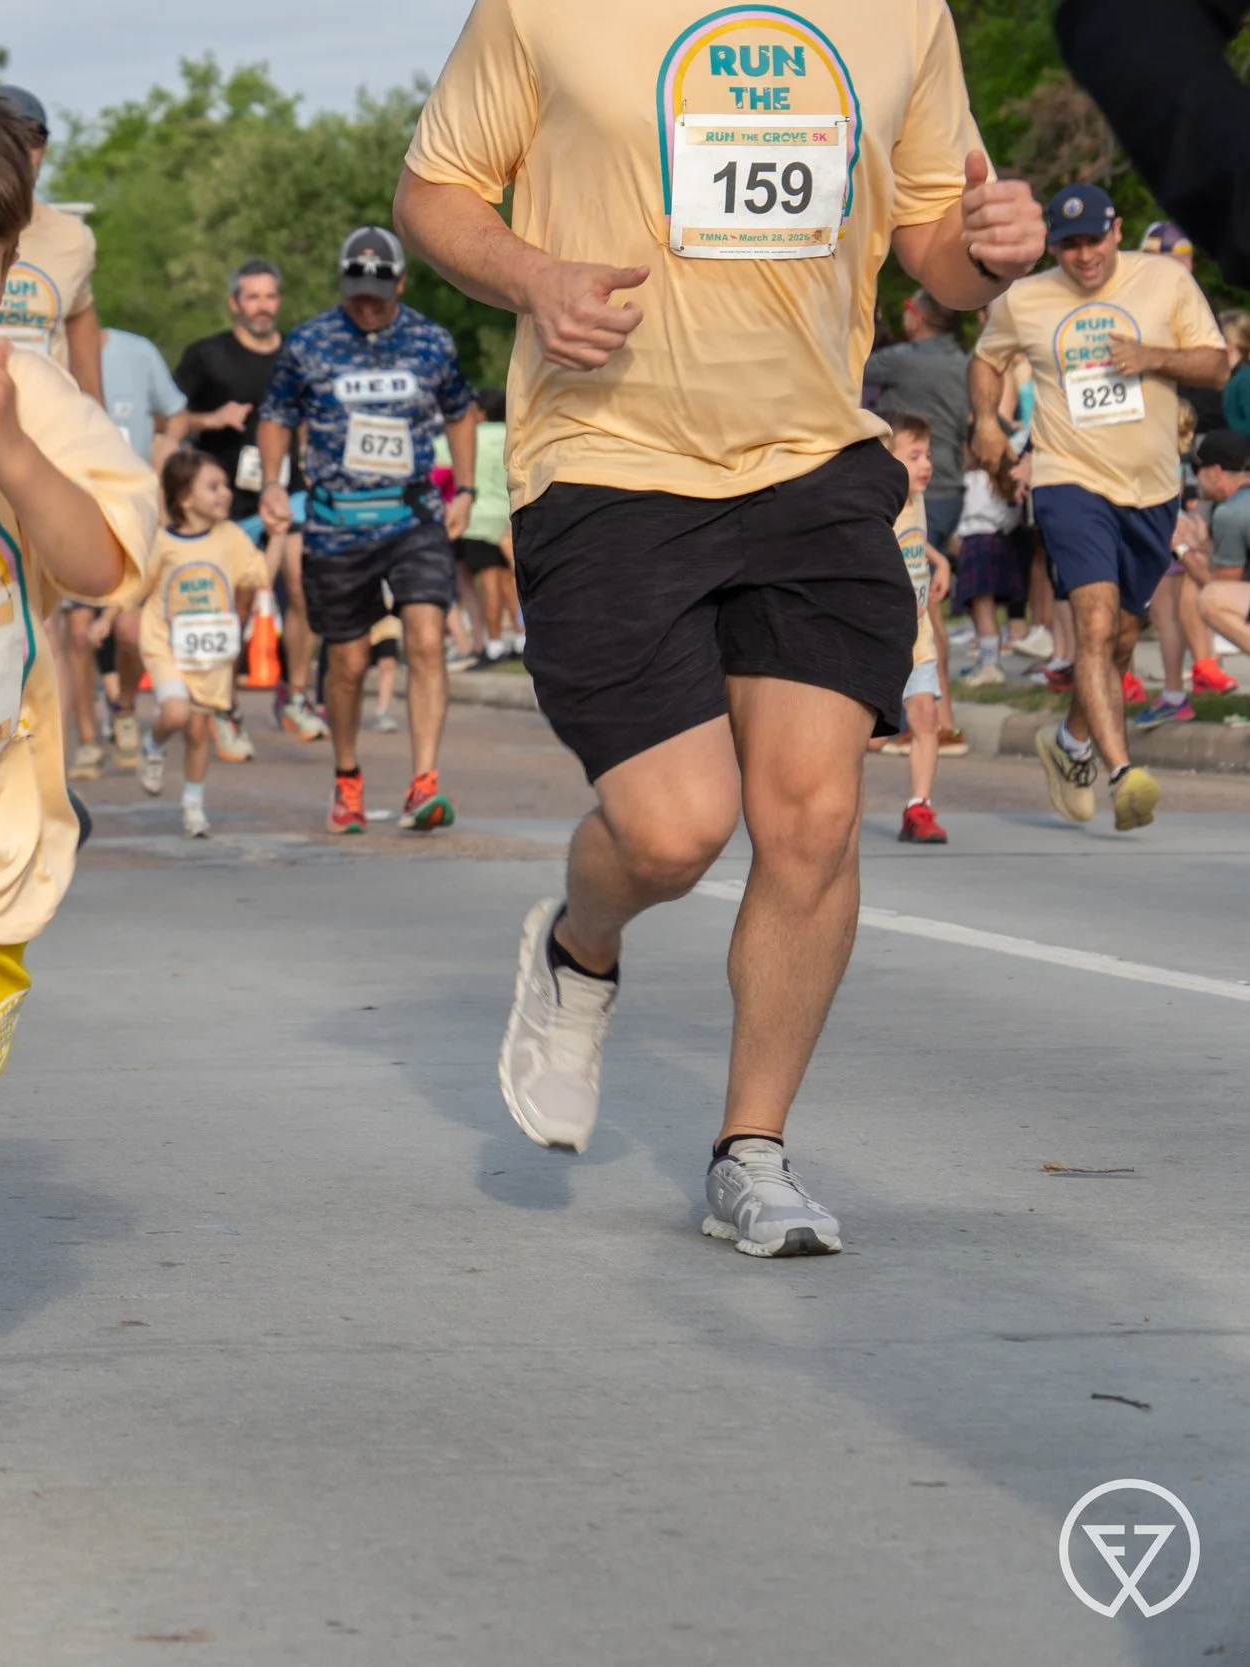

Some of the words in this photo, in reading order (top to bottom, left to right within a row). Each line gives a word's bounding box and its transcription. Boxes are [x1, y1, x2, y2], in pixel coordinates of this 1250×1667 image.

[709, 45, 806, 77] RUN
[729, 86, 791, 111] THE
[705, 131, 735, 142] RUN
[741, 133, 759, 142] THE
[762, 132, 807, 142] GROVE
[812, 132, 827, 142] 5K
[713, 161, 813, 215] 159
[699, 233, 729, 241] TMNA
[739, 233, 768, 242] March
[771, 233, 786, 243] 28,
[788, 233, 810, 241] 2026
[1075, 317, 1115, 331] RUN
[1082, 381, 1128, 409] 829
[360, 433, 404, 458] 673
[185, 631, 228, 655] 962
